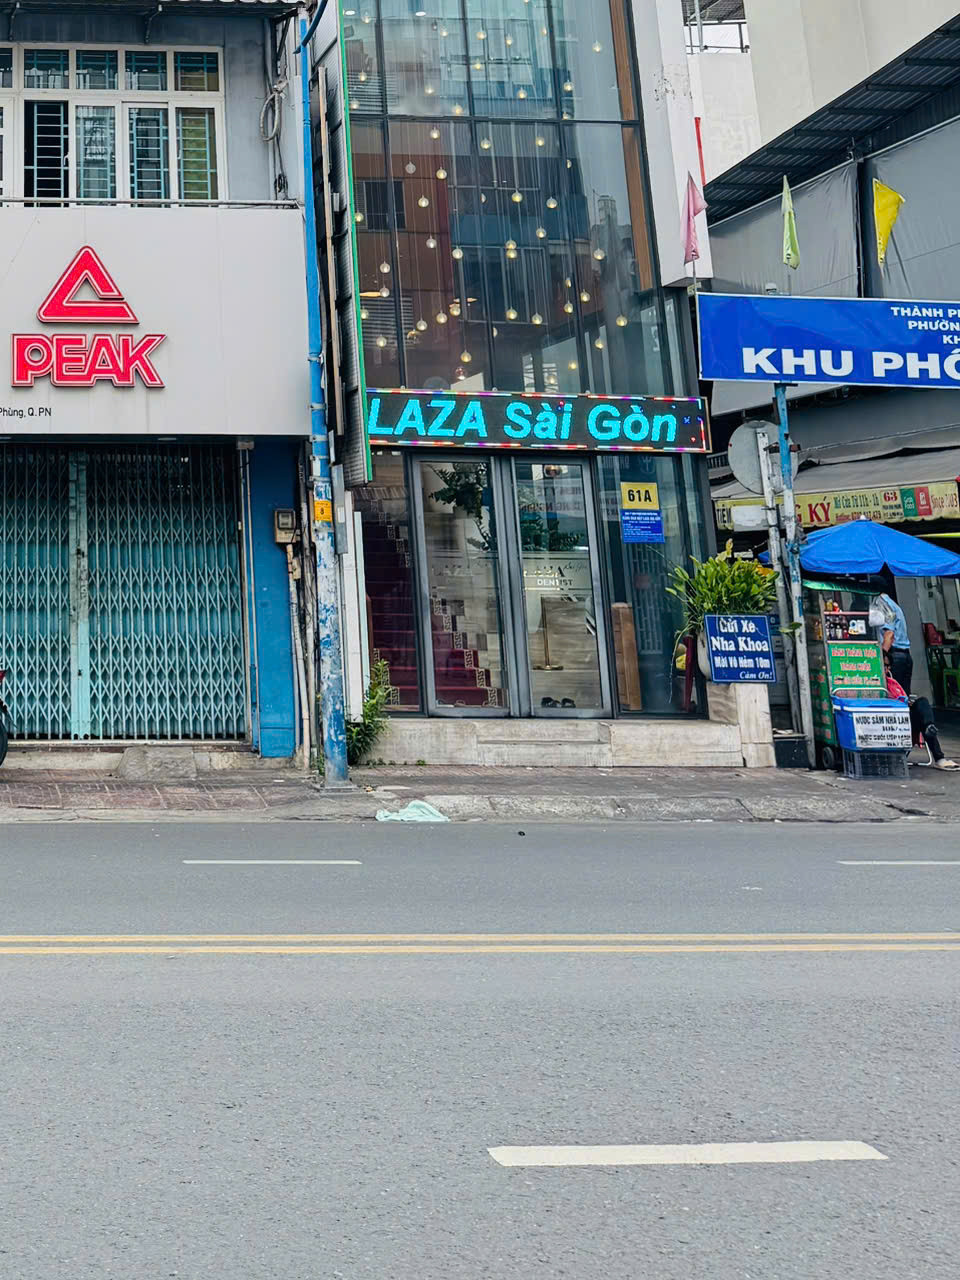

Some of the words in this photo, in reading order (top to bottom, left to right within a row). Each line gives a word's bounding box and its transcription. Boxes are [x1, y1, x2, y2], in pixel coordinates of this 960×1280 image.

[890, 305, 944, 318] THÀNH
[10, 333, 168, 388] PEAK
[742, 347, 854, 377] KHU
[367, 397, 489, 438] LAZA
[503, 400, 574, 440] Sài
[587, 404, 678, 442] Gòn
[627, 489, 652, 503] 61A
[883, 489, 898, 503] 63
[808, 495, 831, 523] KÝ
[711, 636, 736, 651] Nha
[737, 637, 769, 652] Khoa
